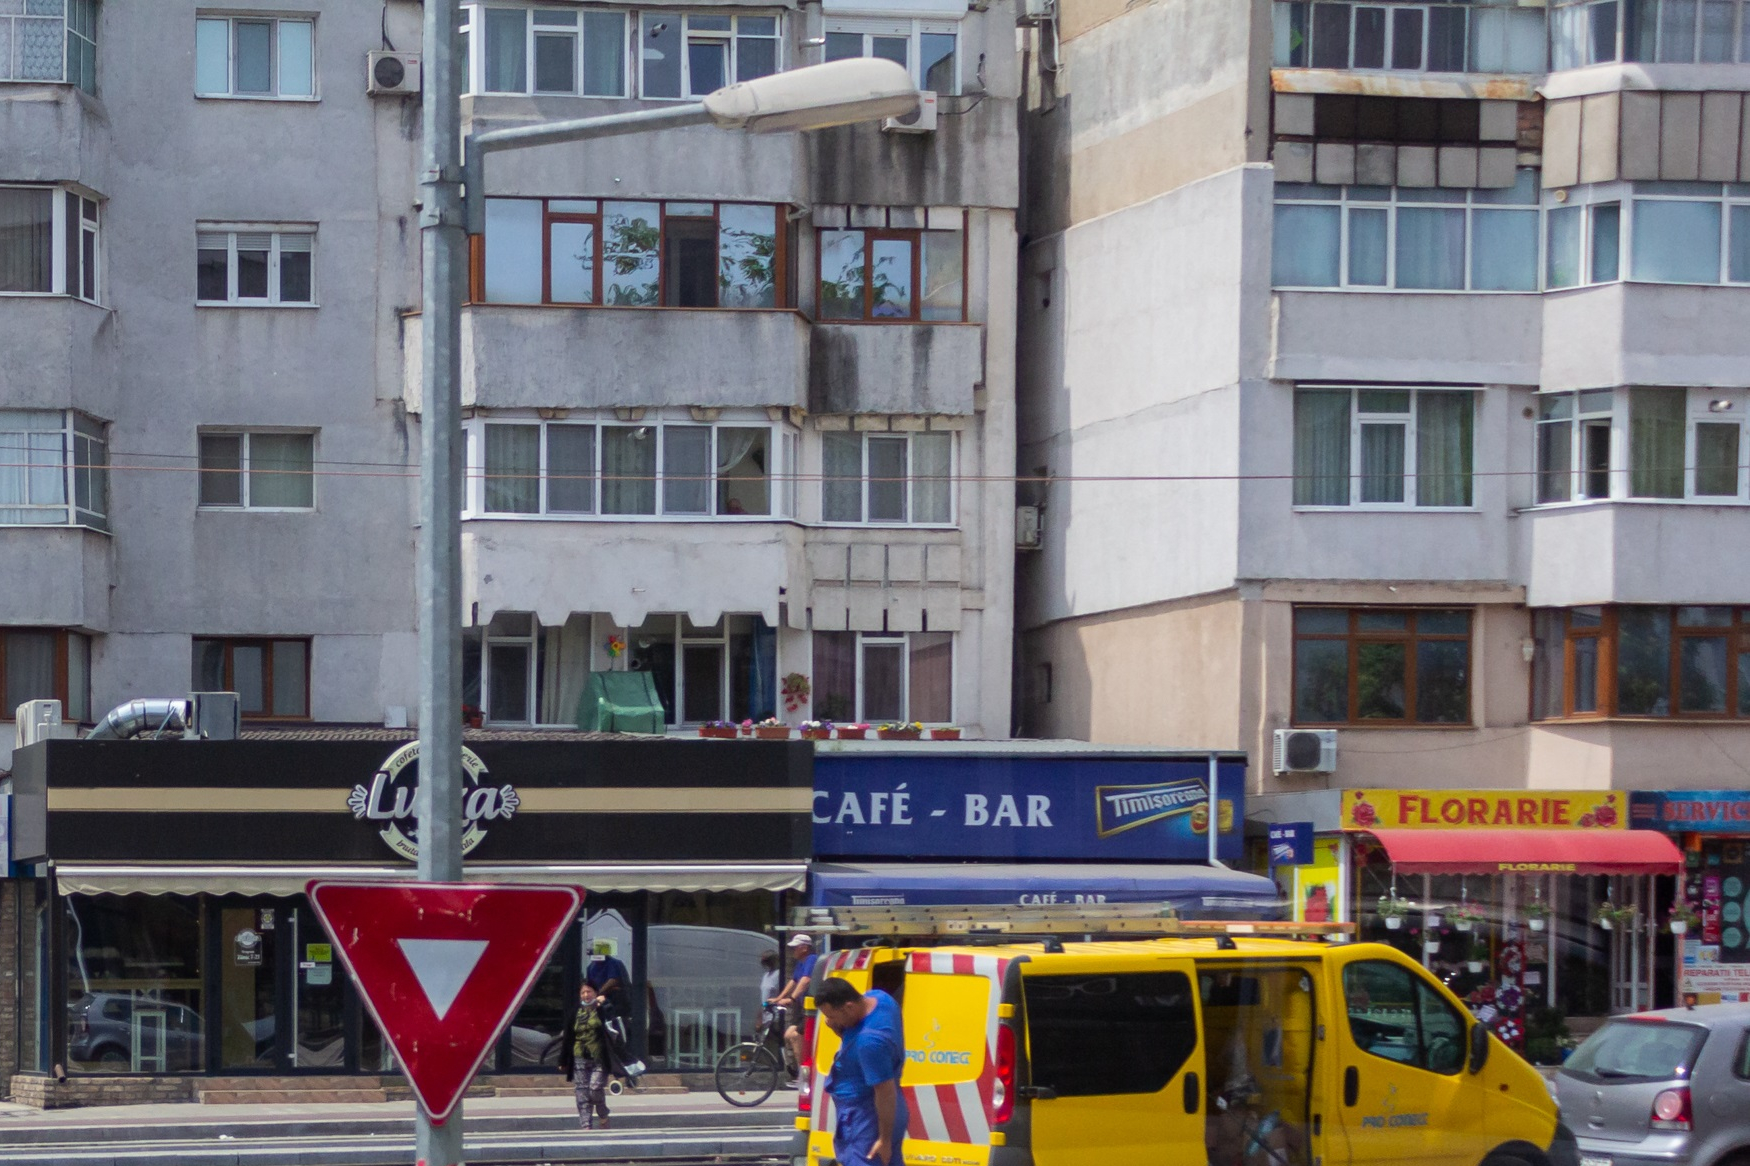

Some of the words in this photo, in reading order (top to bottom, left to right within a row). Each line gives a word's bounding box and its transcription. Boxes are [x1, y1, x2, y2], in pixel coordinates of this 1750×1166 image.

[367, 773, 501, 827] Lua
[812, 782, 913, 825] CAFÉ
[964, 793, 1053, 827] BAR
[1397, 795, 1571, 826] FLORARIE
[1663, 801, 1750, 821] SERVIC
[1498, 862, 1577, 872] FLORARIE
[1075, 894, 1106, 905] BAR
